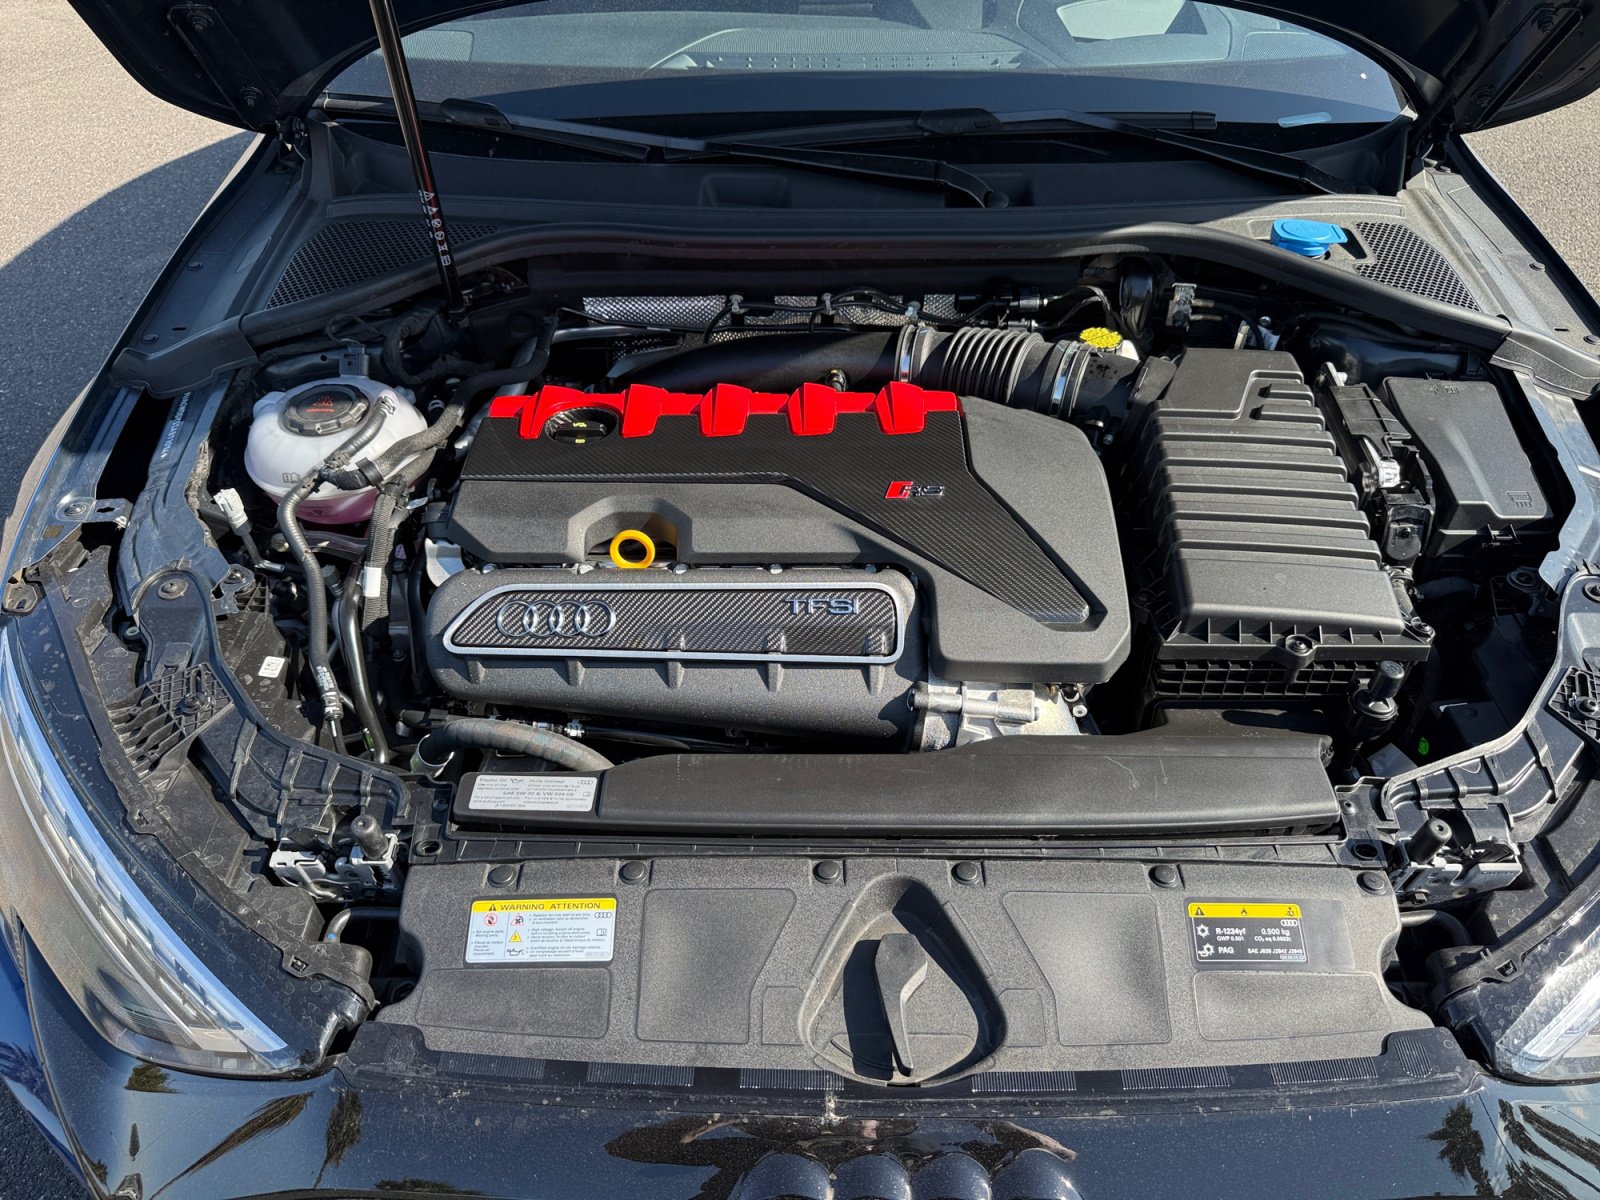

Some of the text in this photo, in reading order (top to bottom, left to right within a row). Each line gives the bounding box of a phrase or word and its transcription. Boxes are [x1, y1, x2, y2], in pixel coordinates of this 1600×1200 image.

[899, 484, 945, 498] RS
[784, 596, 860, 615] TFSI
[500, 903, 545, 911] WARNING
[550, 902, 601, 910] ATTENTION
[1215, 927, 1246, 936] R-1234yf
[1281, 927, 1290, 936] kg
[1218, 946, 1234, 954] PAG
